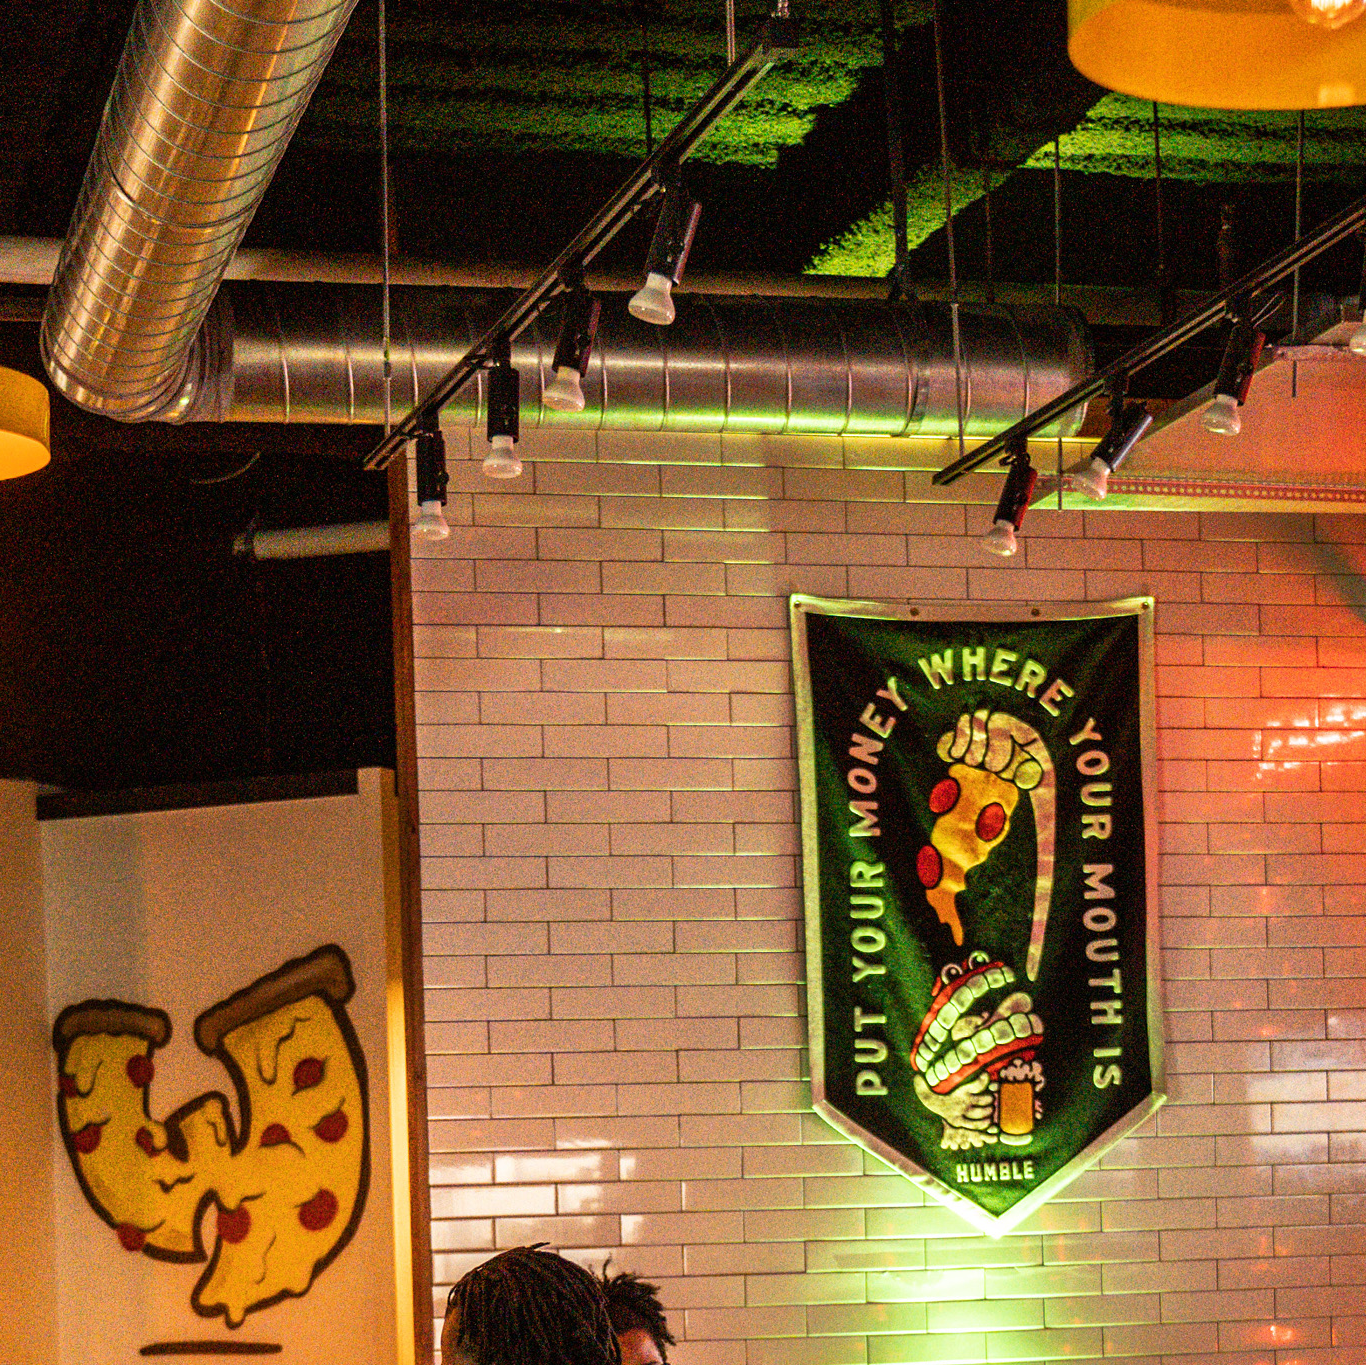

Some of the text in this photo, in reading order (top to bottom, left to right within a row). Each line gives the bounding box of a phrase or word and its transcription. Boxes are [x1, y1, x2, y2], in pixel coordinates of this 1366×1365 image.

[847, 646, 1123, 1096] PUT YOUR MONEY WHERE YOUR MOUTH IS
[956, 1160, 1035, 1183] HUMBLE
